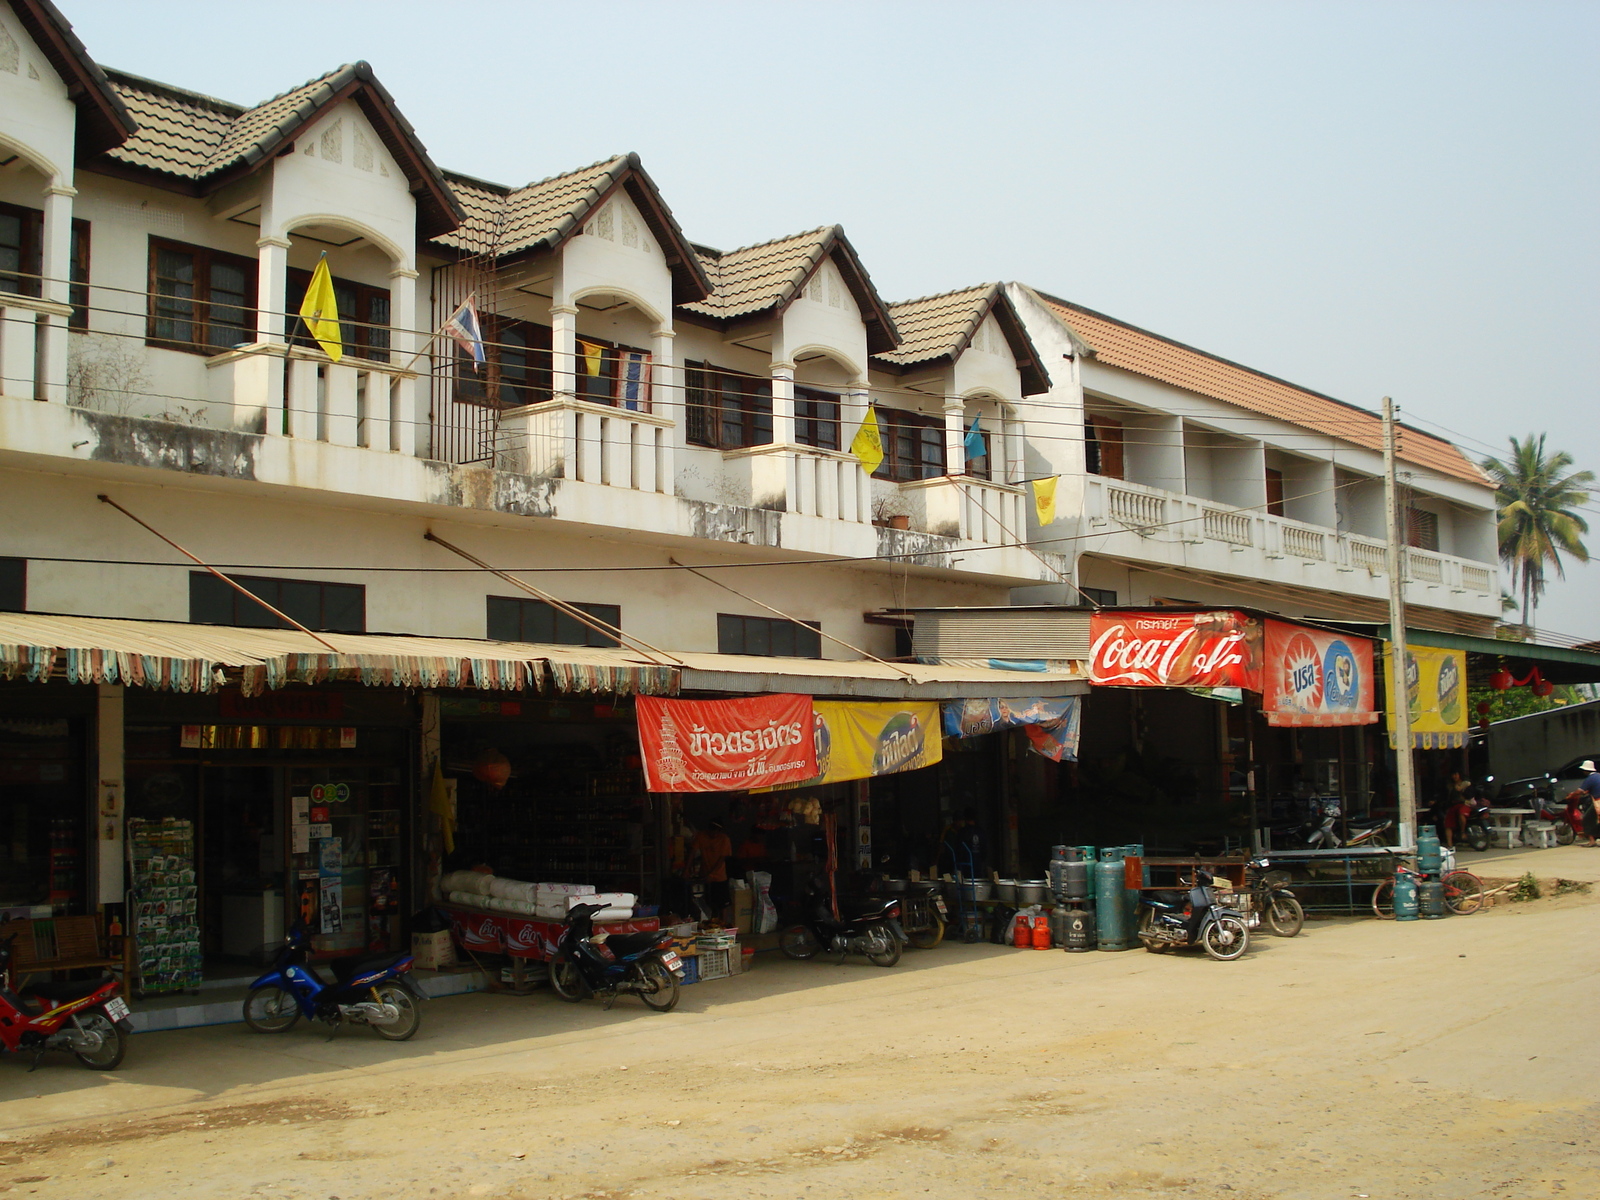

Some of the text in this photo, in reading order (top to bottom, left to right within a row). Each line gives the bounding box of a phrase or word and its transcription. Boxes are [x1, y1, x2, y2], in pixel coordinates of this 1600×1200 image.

[689, 719, 803, 757] ข้าวตราฉัตร
